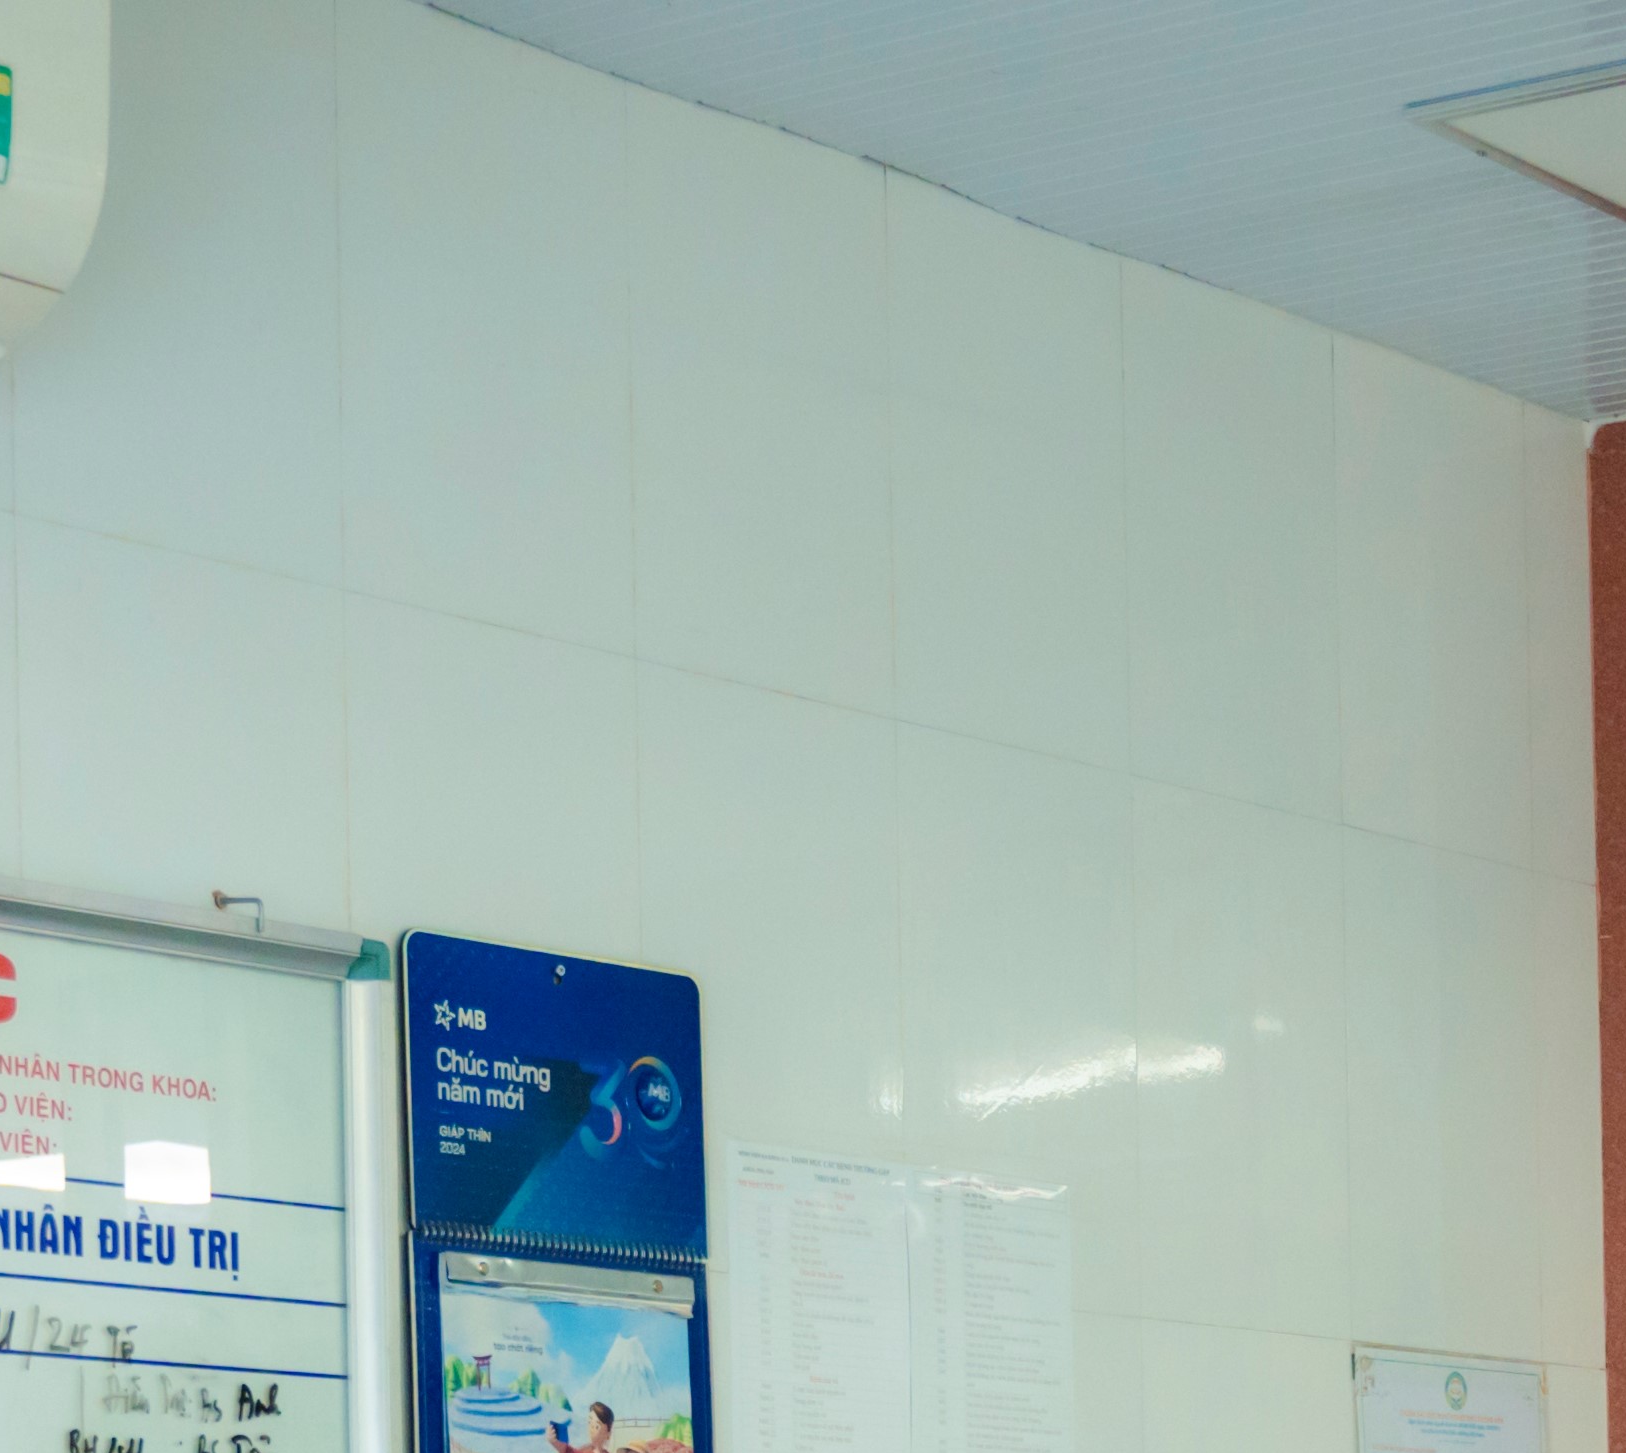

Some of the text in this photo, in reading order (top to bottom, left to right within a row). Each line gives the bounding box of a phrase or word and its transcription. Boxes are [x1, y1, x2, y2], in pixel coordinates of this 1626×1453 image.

[457, 1008, 487, 1031] MB
[67, 1062, 144, 1092] TRONG
[151, 1074, 216, 1101] KHOA:
[436, 1047, 551, 1093] Chúc mừng
[14, 1092, 72, 1121] VIỆN:
[437, 1078, 525, 1111] năm mới
[439, 1125, 491, 1142] GIÁP THÌN
[440, 1142, 465, 1155] 2024
[97, 1206, 176, 1266] ĐIỀU
[189, 1228, 239, 1280] TRỊ
